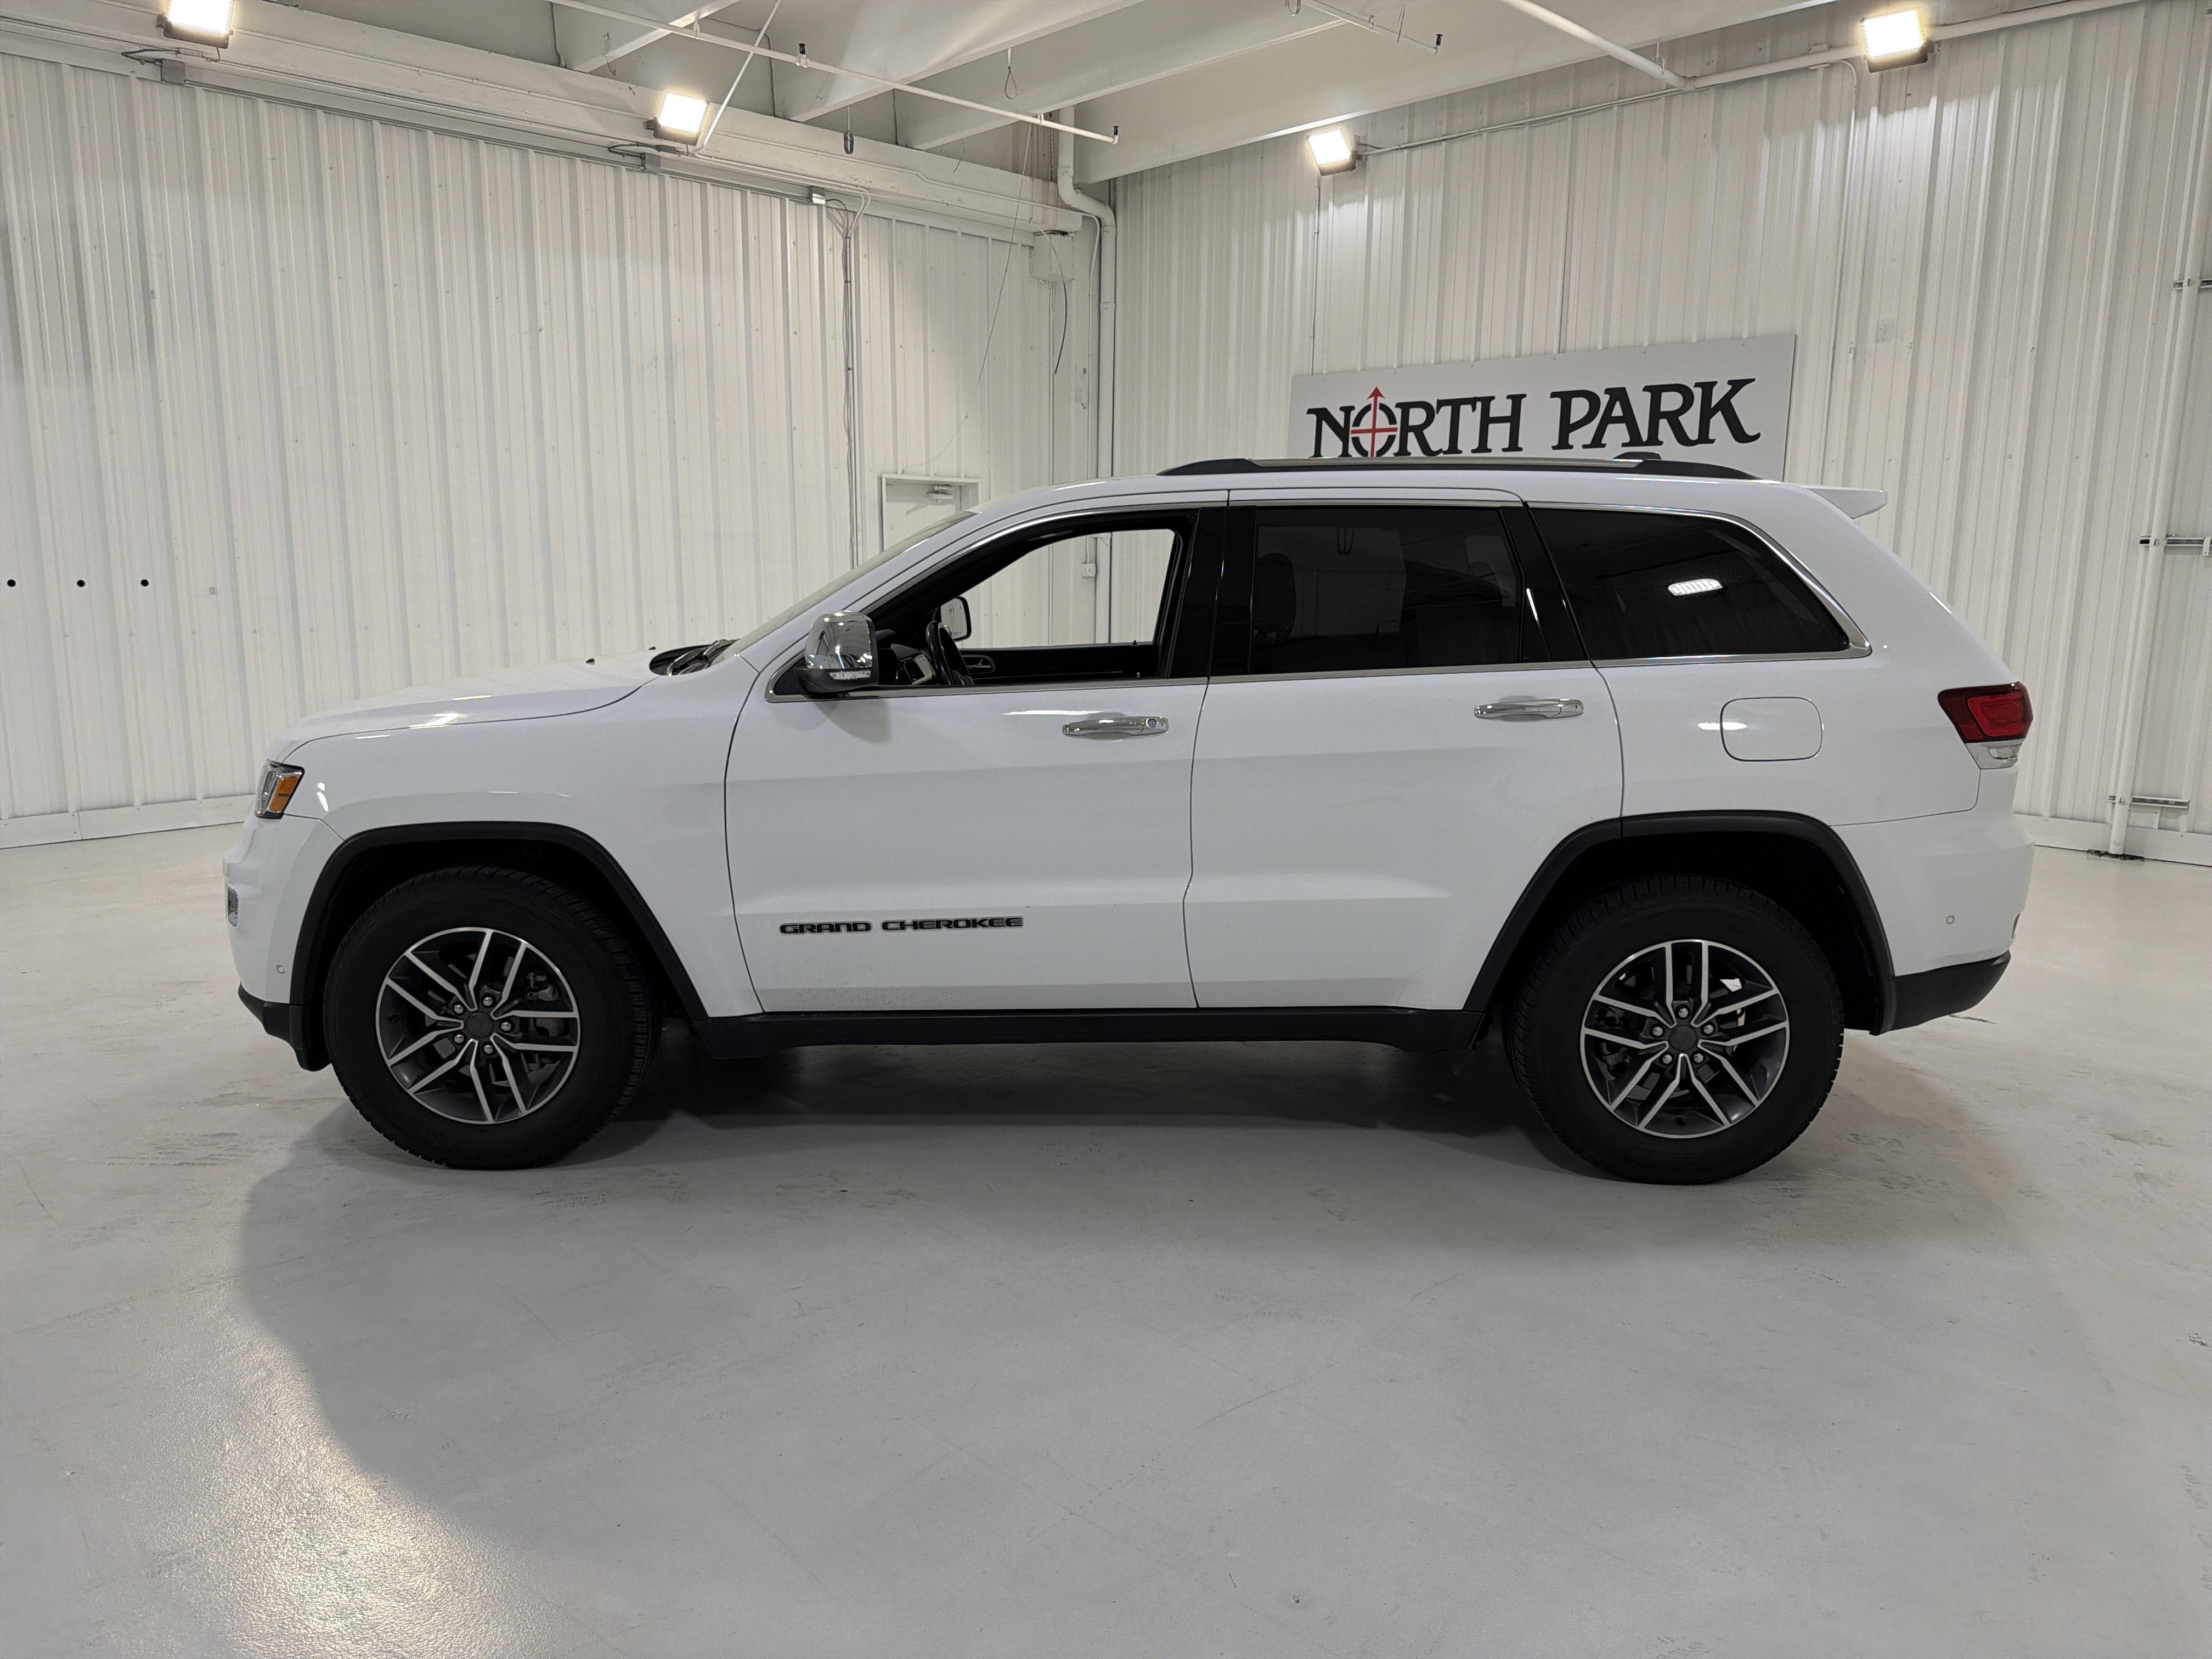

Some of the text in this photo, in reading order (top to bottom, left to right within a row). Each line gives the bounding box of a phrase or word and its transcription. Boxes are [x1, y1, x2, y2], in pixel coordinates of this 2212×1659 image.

[1306, 377, 1761, 458] NORTH PARK
[780, 916, 1024, 934] GRAND CHEROKEE
